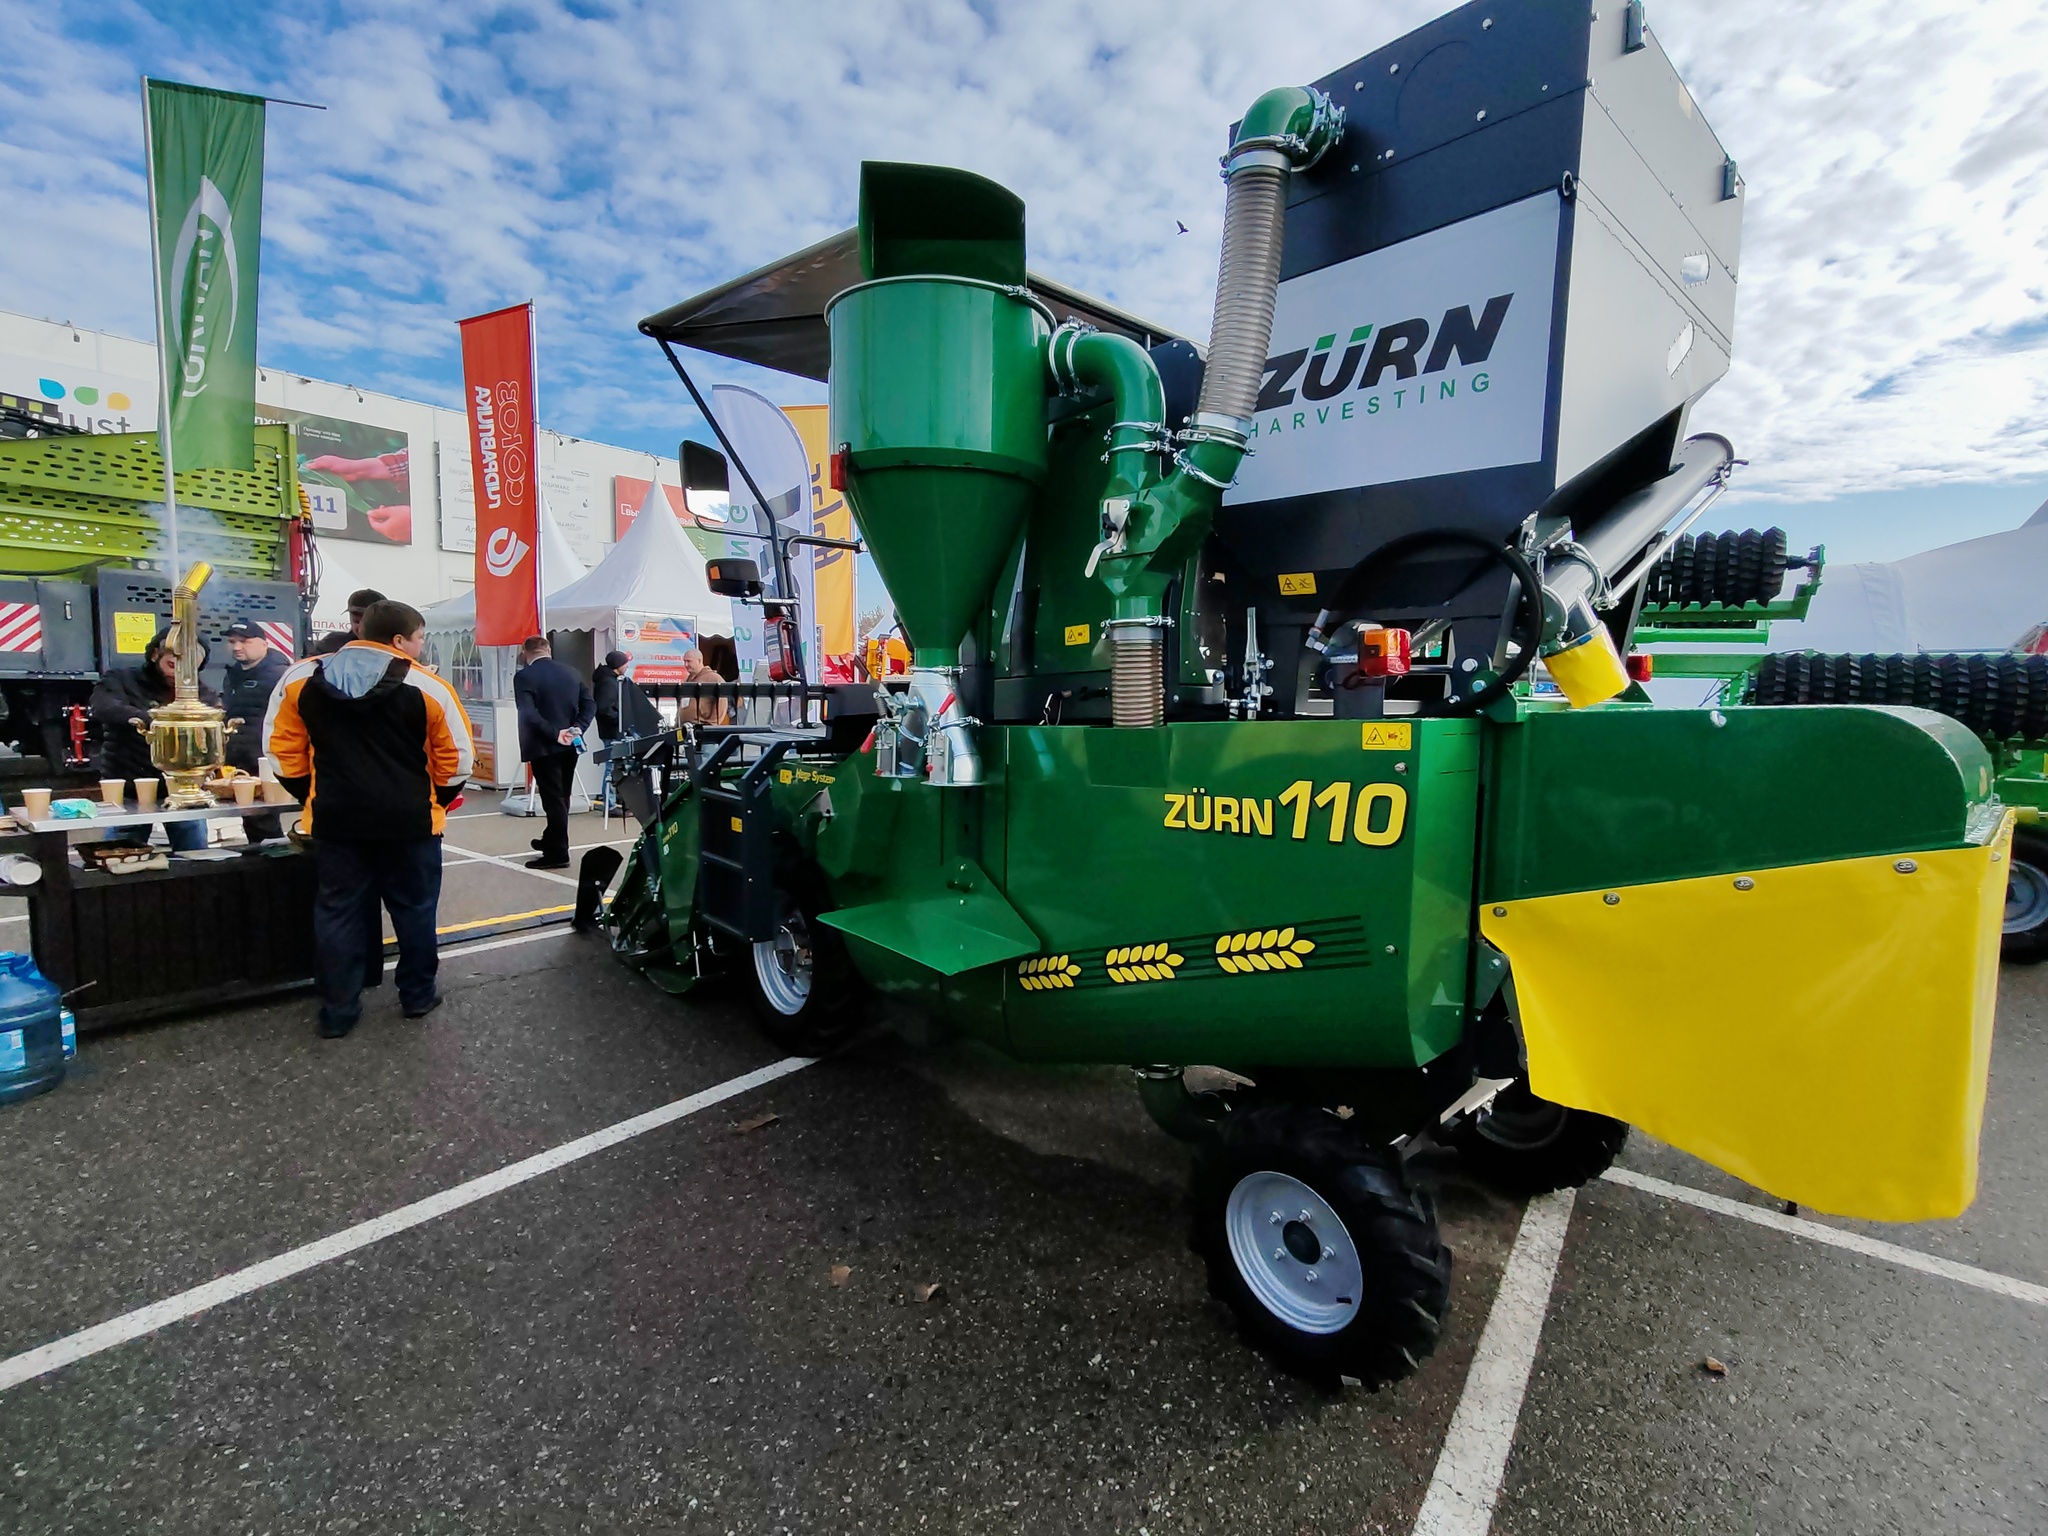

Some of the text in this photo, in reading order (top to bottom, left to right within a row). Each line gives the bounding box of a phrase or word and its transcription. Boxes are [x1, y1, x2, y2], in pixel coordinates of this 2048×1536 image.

[1255, 292, 1515, 413] ZÜRN
[1248, 373, 1491, 439] HARVESTING
[313, 620, 336, 629] ППА
[1162, 780, 1408, 847] ZÜRN 110
